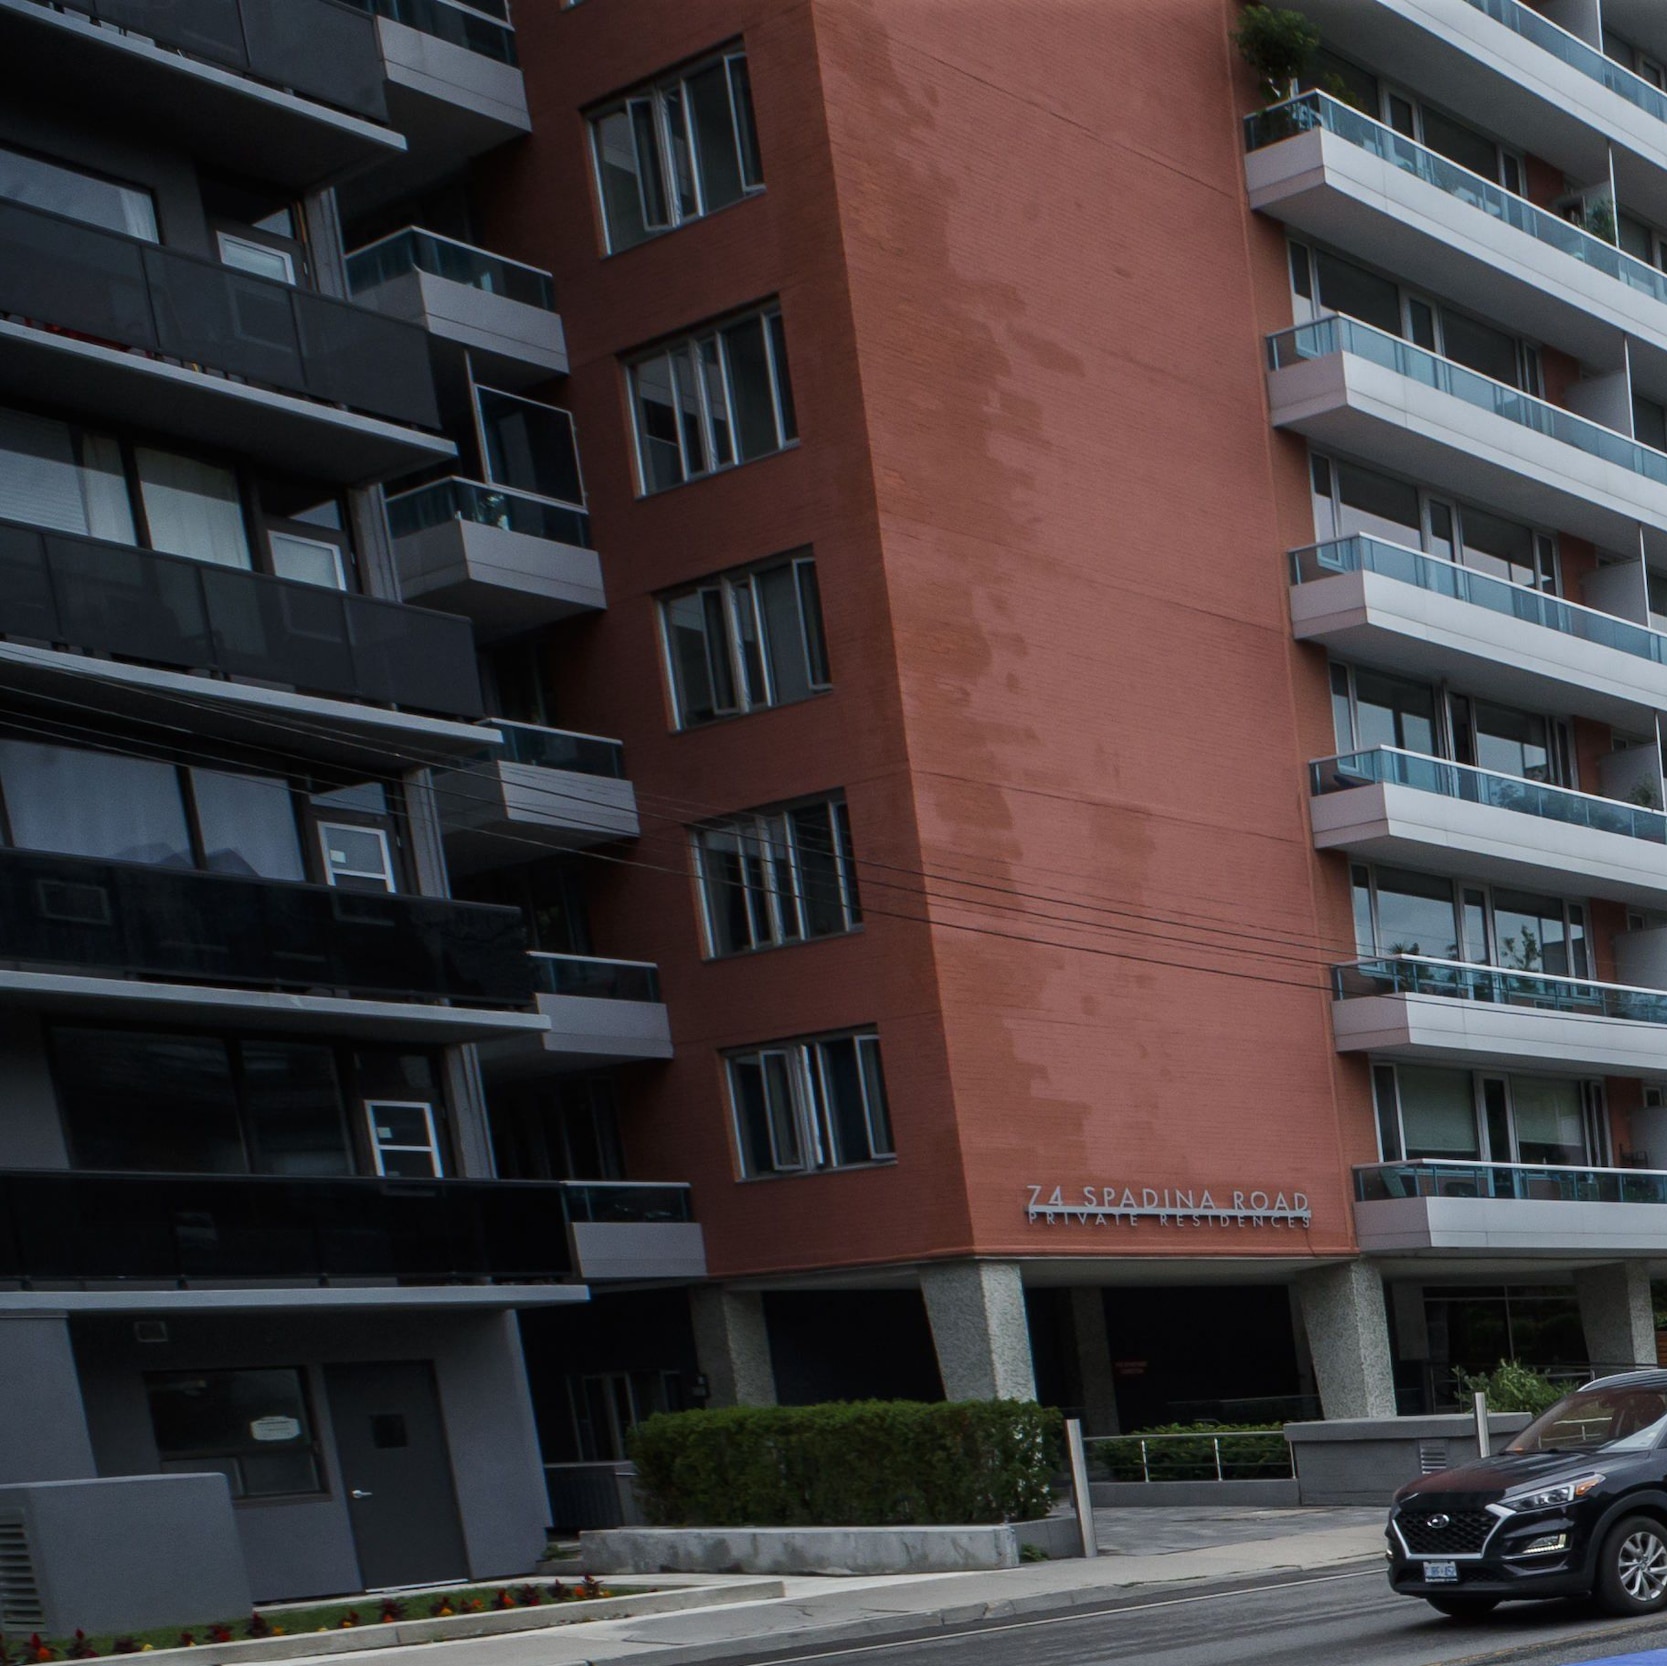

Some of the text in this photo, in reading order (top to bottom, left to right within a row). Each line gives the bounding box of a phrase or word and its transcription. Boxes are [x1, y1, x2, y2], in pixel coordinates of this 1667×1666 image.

[1026, 1184, 1310, 1213] 74 SPADINA ROAD
[1028, 1211, 1311, 1229] PRIVATE RESIDENCES
